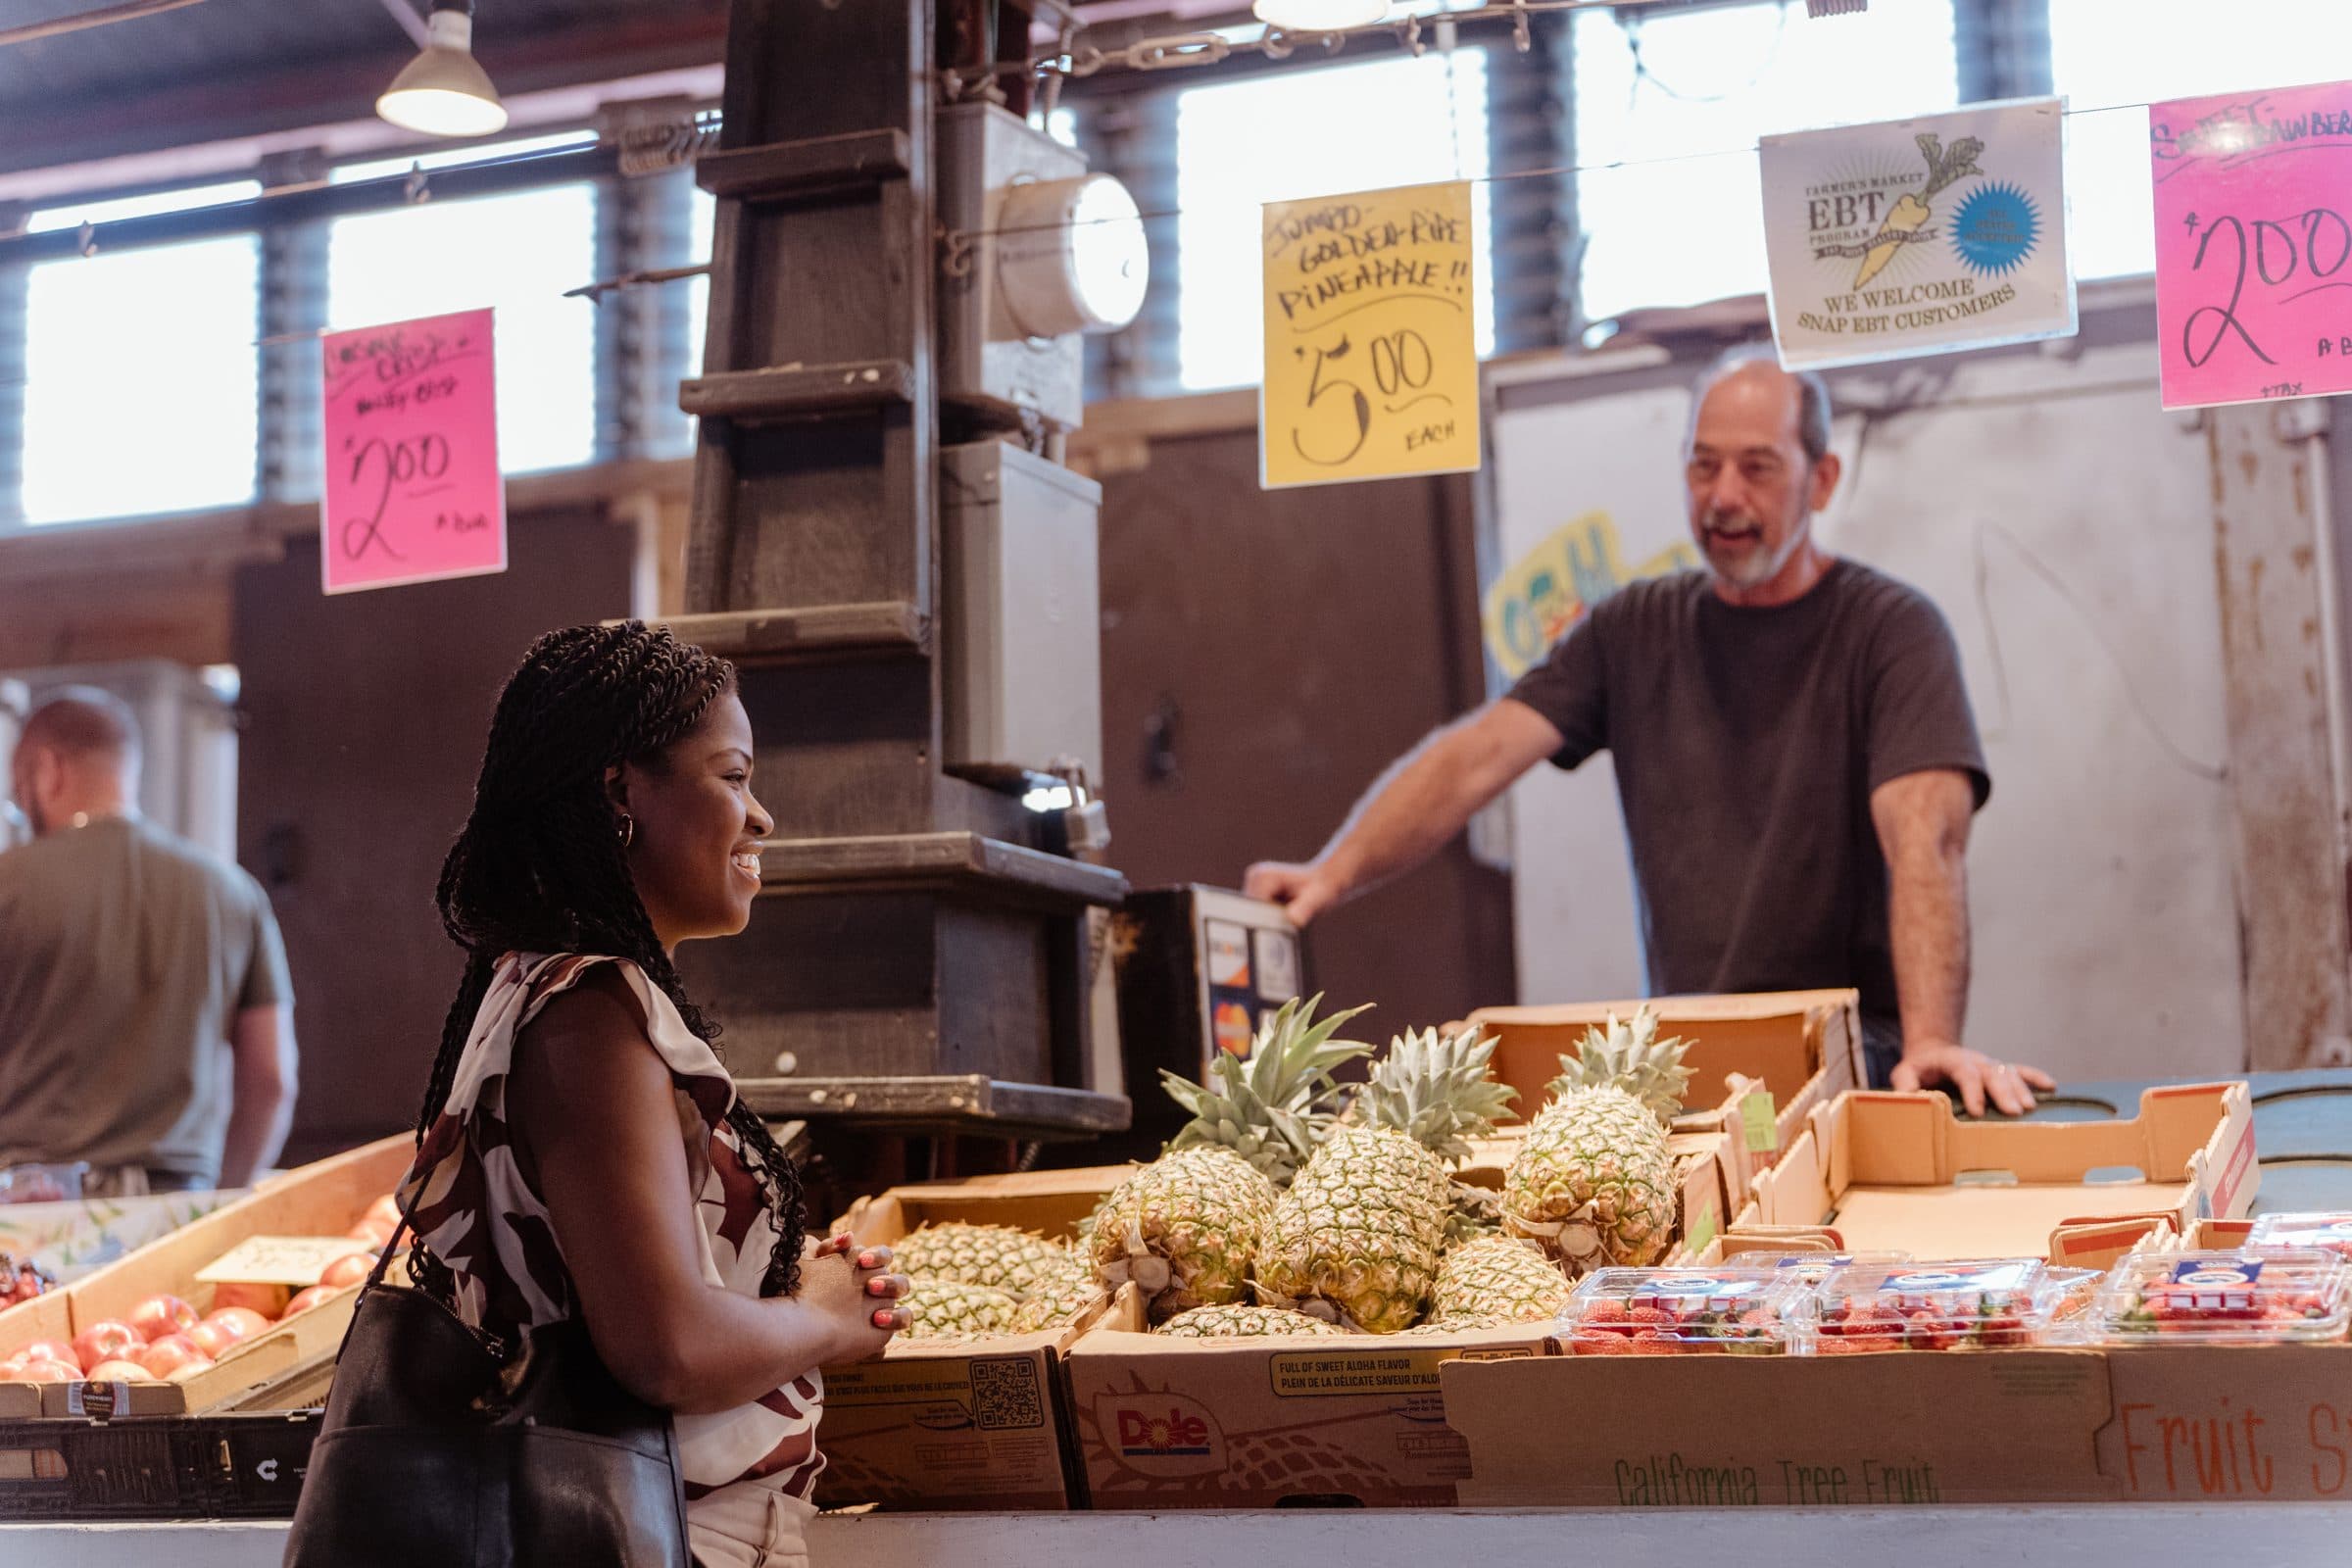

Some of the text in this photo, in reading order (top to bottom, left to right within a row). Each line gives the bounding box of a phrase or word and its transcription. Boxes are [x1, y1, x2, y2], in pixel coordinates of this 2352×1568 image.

[1871, 172, 1925, 188] MARKET
[1808, 191, 1886, 231] EBT
[1809, 227, 1870, 246] PROGRAM
[1797, 282, 2018, 333] SNAP EBT CUSTOMERS
[1824, 277, 1976, 316] WE WELCOME
[1405, 419, 1457, 453] EACH
[1279, 1358, 1410, 1373] FULL OF SWEET ALOHA FLAVOR
[1281, 1377, 1306, 1389] PLEIN
[1308, 1376, 1320, 1388] DE
[1321, 1376, 1333, 1388] LA
[1334, 1373, 1374, 1387] DÉLICATE
[1376, 1374, 1411, 1386] SAVEUR
[1116, 1407, 1209, 1450] Dole
[2120, 1395, 2352, 1495] Fruit S
[1614, 1451, 1939, 1506] California Tree Fruit
